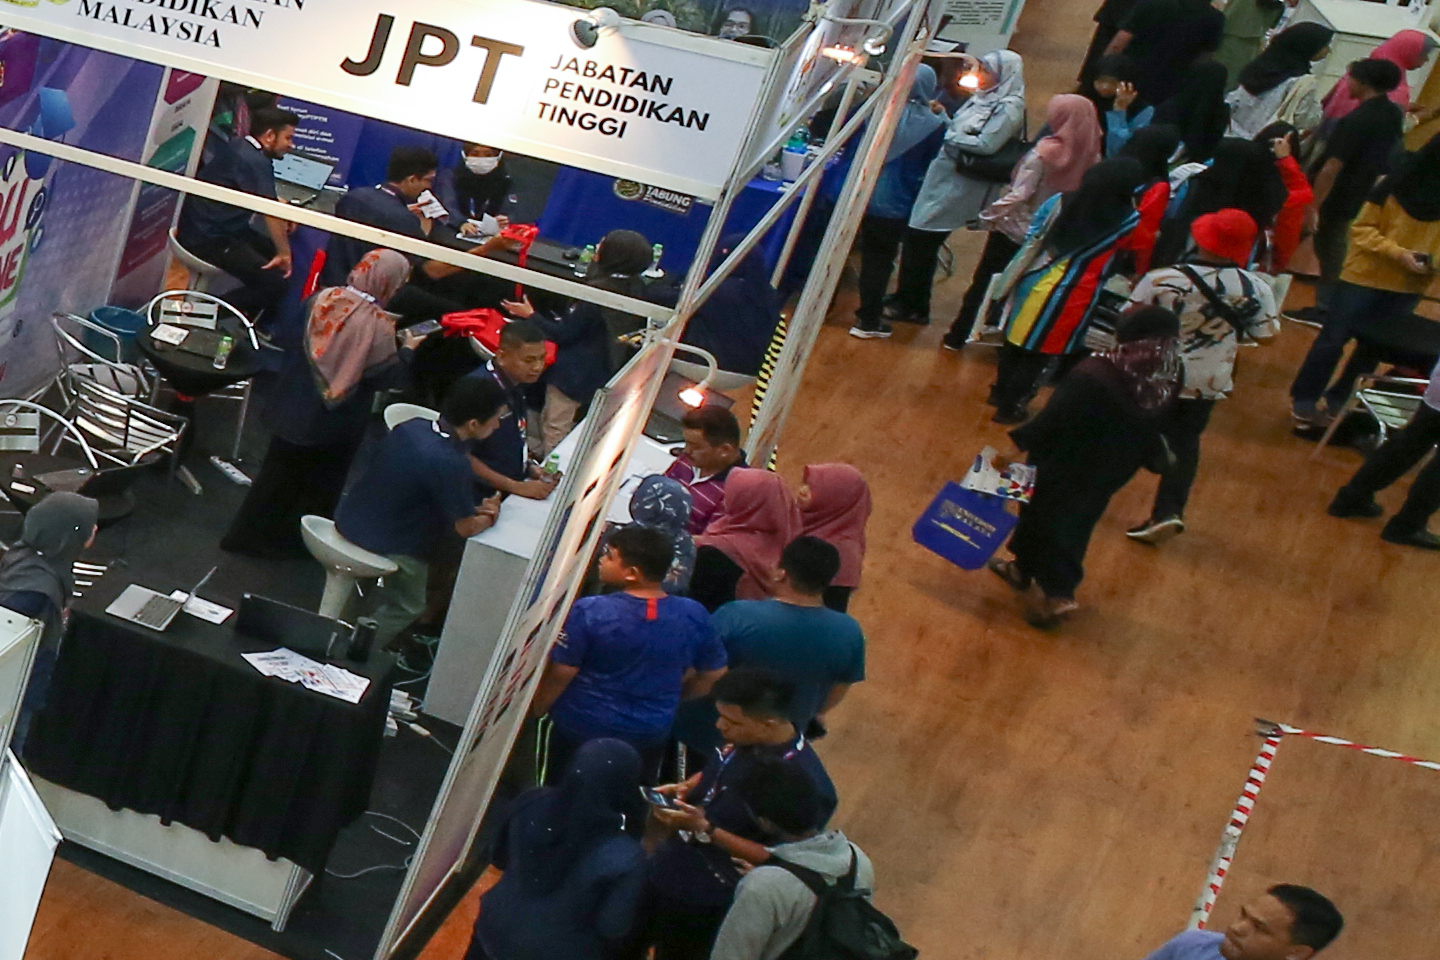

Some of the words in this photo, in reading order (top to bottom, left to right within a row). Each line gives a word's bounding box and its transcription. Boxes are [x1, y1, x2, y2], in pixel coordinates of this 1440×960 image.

[339, 12, 525, 107] JPT
[549, 53, 675, 98] JABATAN
[535, 99, 629, 141] TINGGI
[542, 76, 710, 132] PENDIDIKAN
[646, 186, 691, 207] TABUNG
